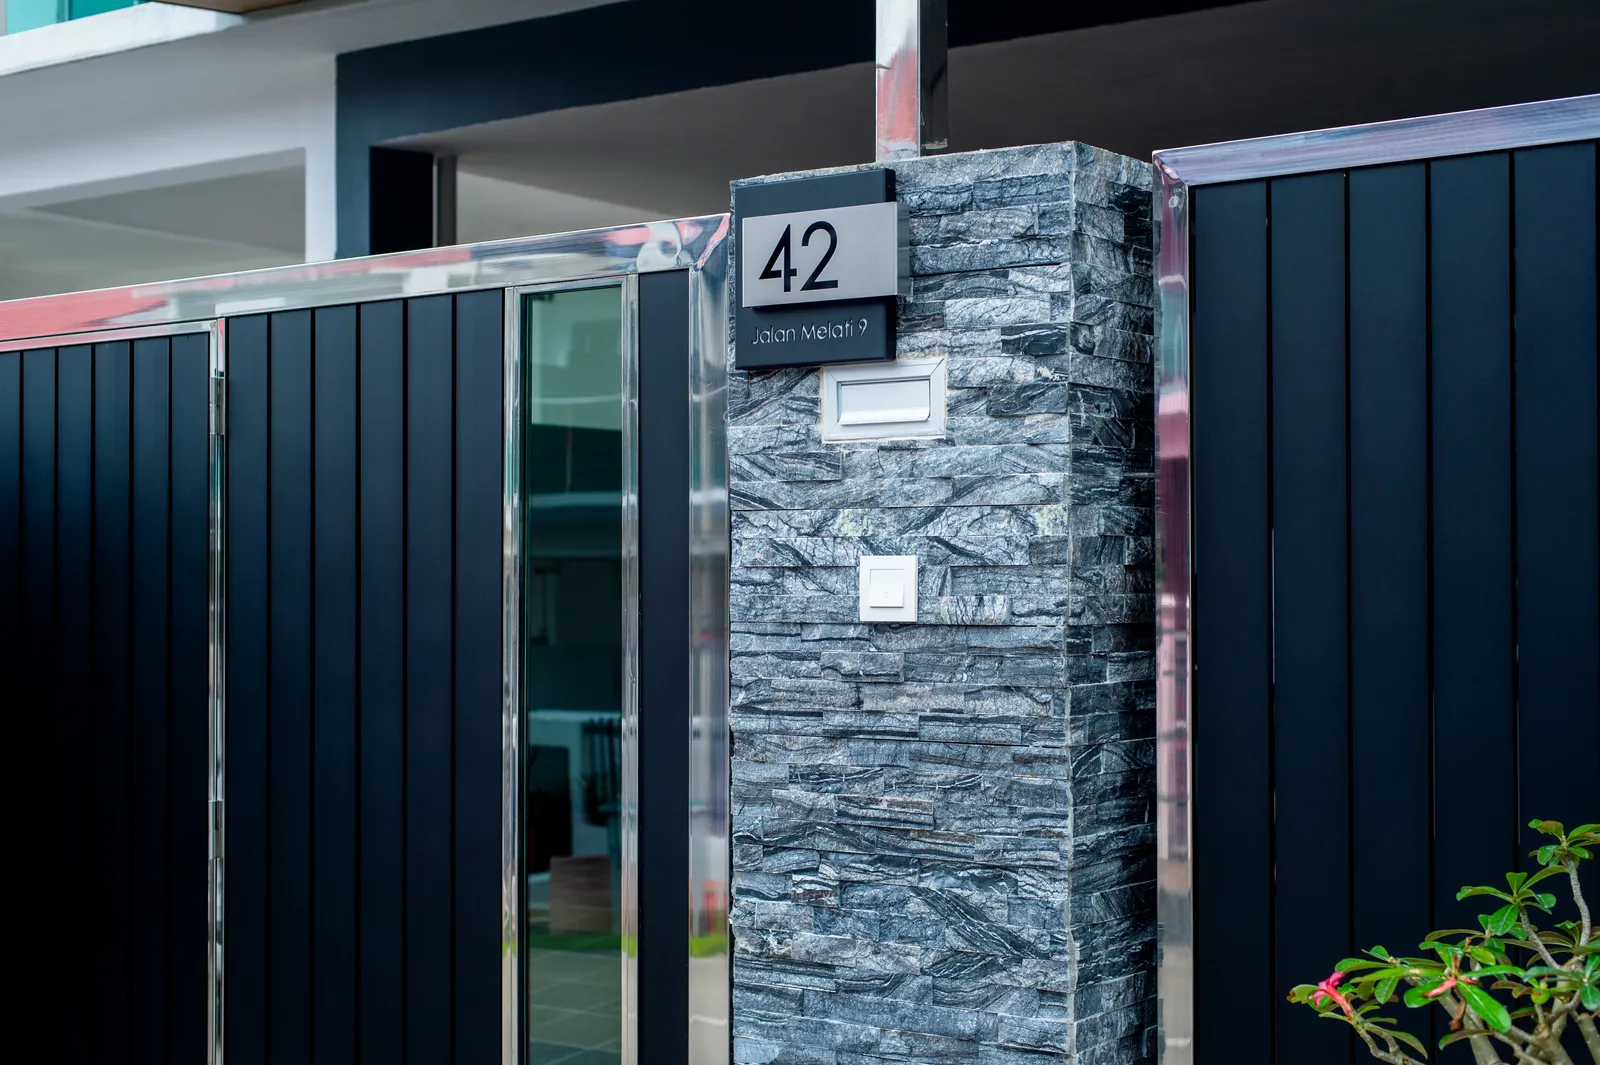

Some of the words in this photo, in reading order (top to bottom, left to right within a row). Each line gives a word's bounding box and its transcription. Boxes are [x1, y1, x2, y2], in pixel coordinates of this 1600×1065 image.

[758, 220, 839, 293] 42
[752, 325, 796, 345] Jalan
[801, 319, 853, 341] Melati
[858, 318, 868, 336] 9
